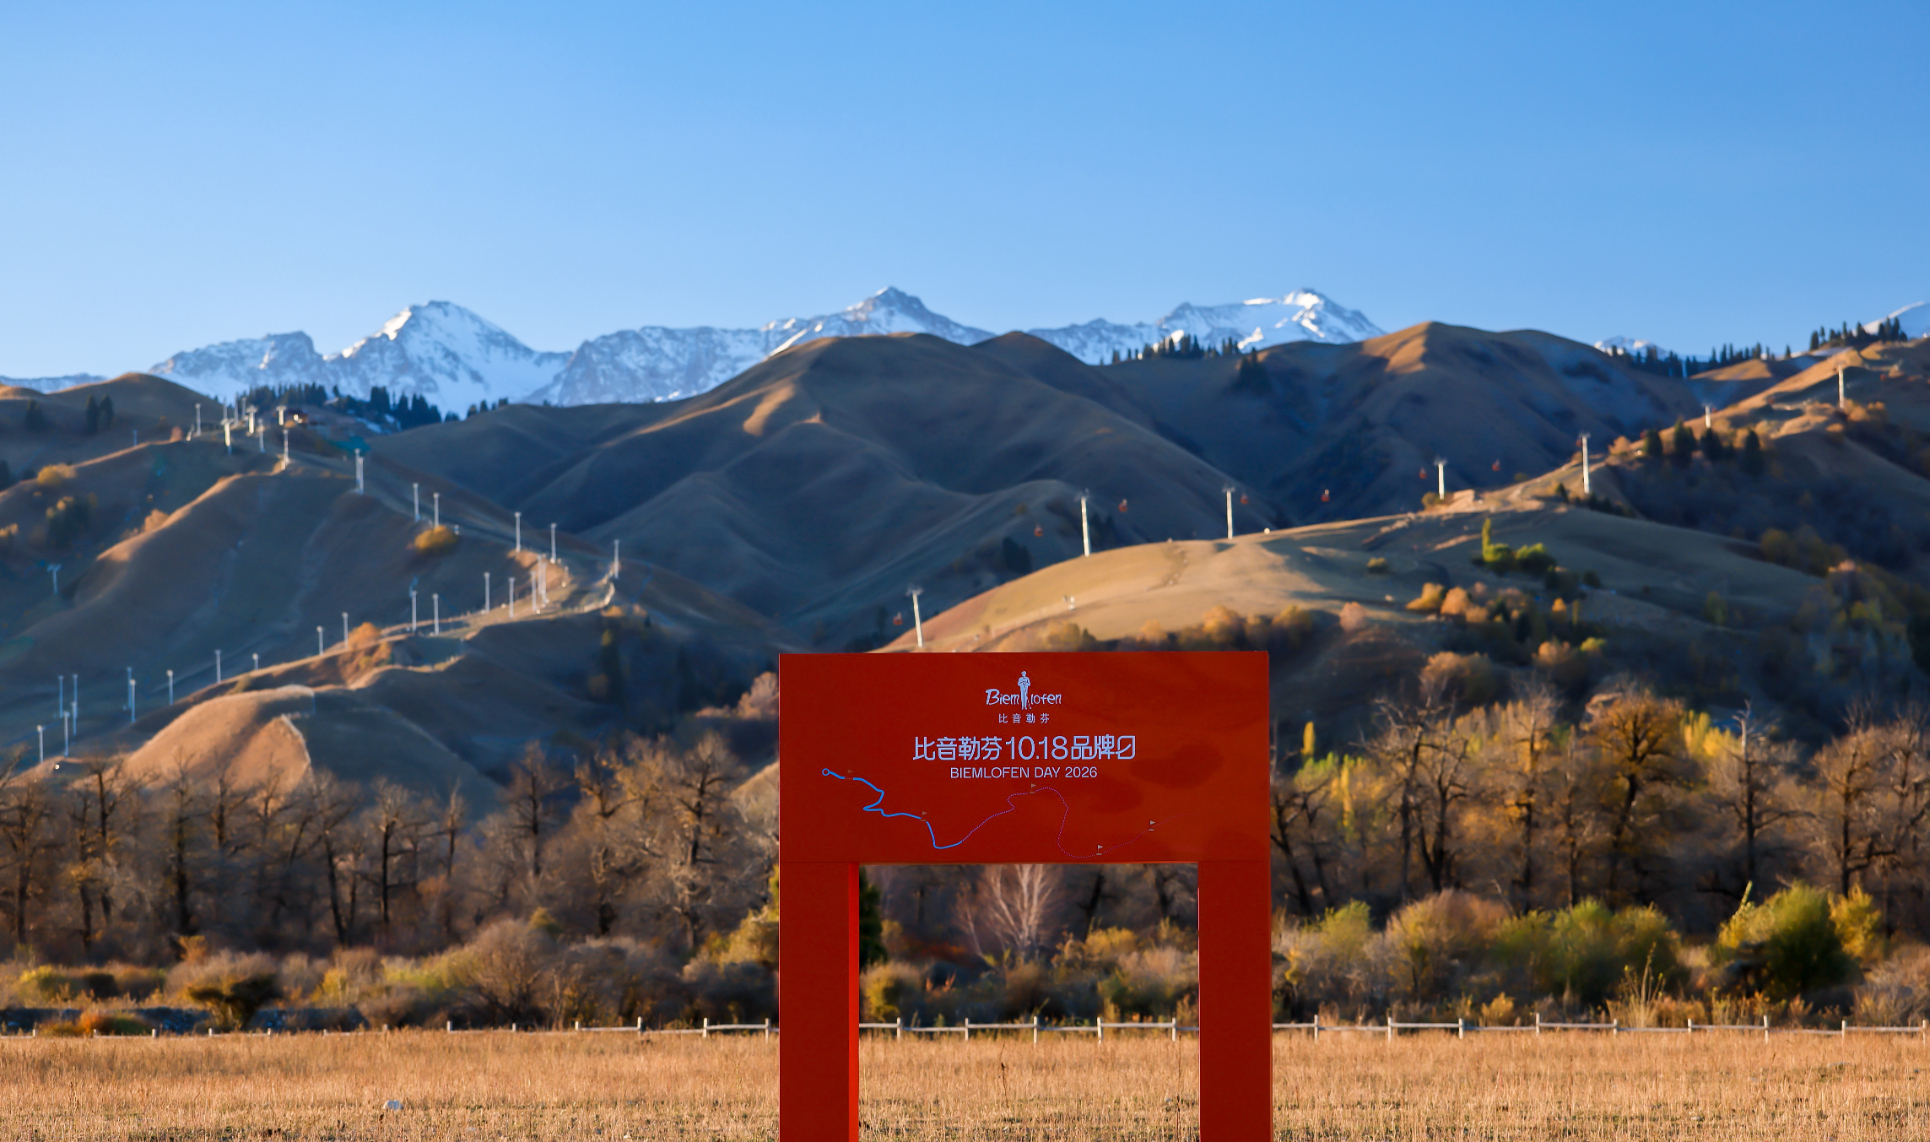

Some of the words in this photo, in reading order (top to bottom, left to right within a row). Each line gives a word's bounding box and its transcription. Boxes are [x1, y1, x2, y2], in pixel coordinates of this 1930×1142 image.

[998, 713, 1050, 724] 比音勒芬
[950, 767, 1030, 779] BIEMLOFEN
[1034, 767, 1061, 779] DAY
[1065, 766, 1098, 778] 2026
